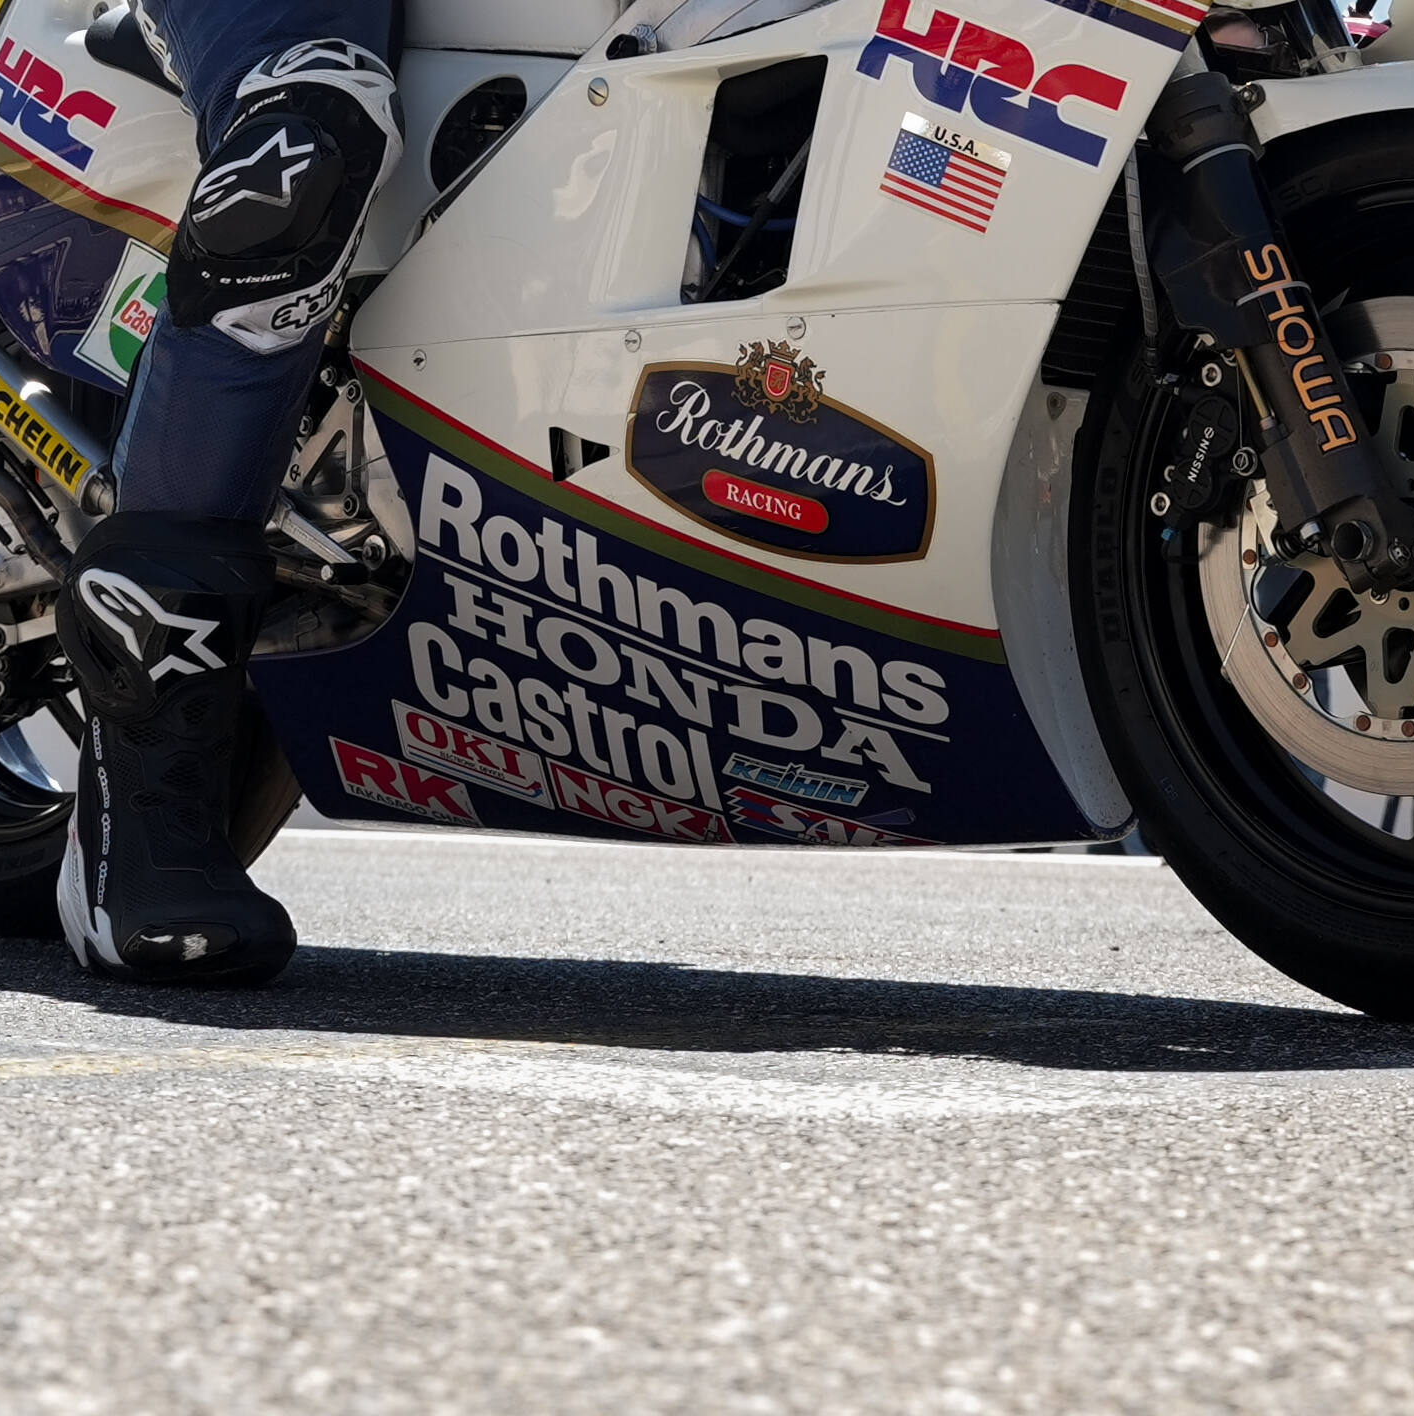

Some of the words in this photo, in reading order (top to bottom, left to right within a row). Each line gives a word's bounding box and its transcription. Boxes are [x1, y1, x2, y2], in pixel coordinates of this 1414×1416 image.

[933, 124, 979, 158] U.S.A.
[1243, 242, 1360, 454] SHOWA
[656, 381, 907, 507] Rothmans
[1187, 439, 1212, 483] NISSIN
[726, 483, 803, 521] RACING
[418, 452, 951, 726] Rothmans
[407, 621, 724, 811] Castrol
[442, 573, 932, 794] HONDA
[334, 739, 474, 820] RK
[406, 711, 526, 780] OKI
[730, 759, 858, 804] KEIHIN
[348, 784, 428, 816] TAKASAGO
[556, 767, 708, 842] NGK
